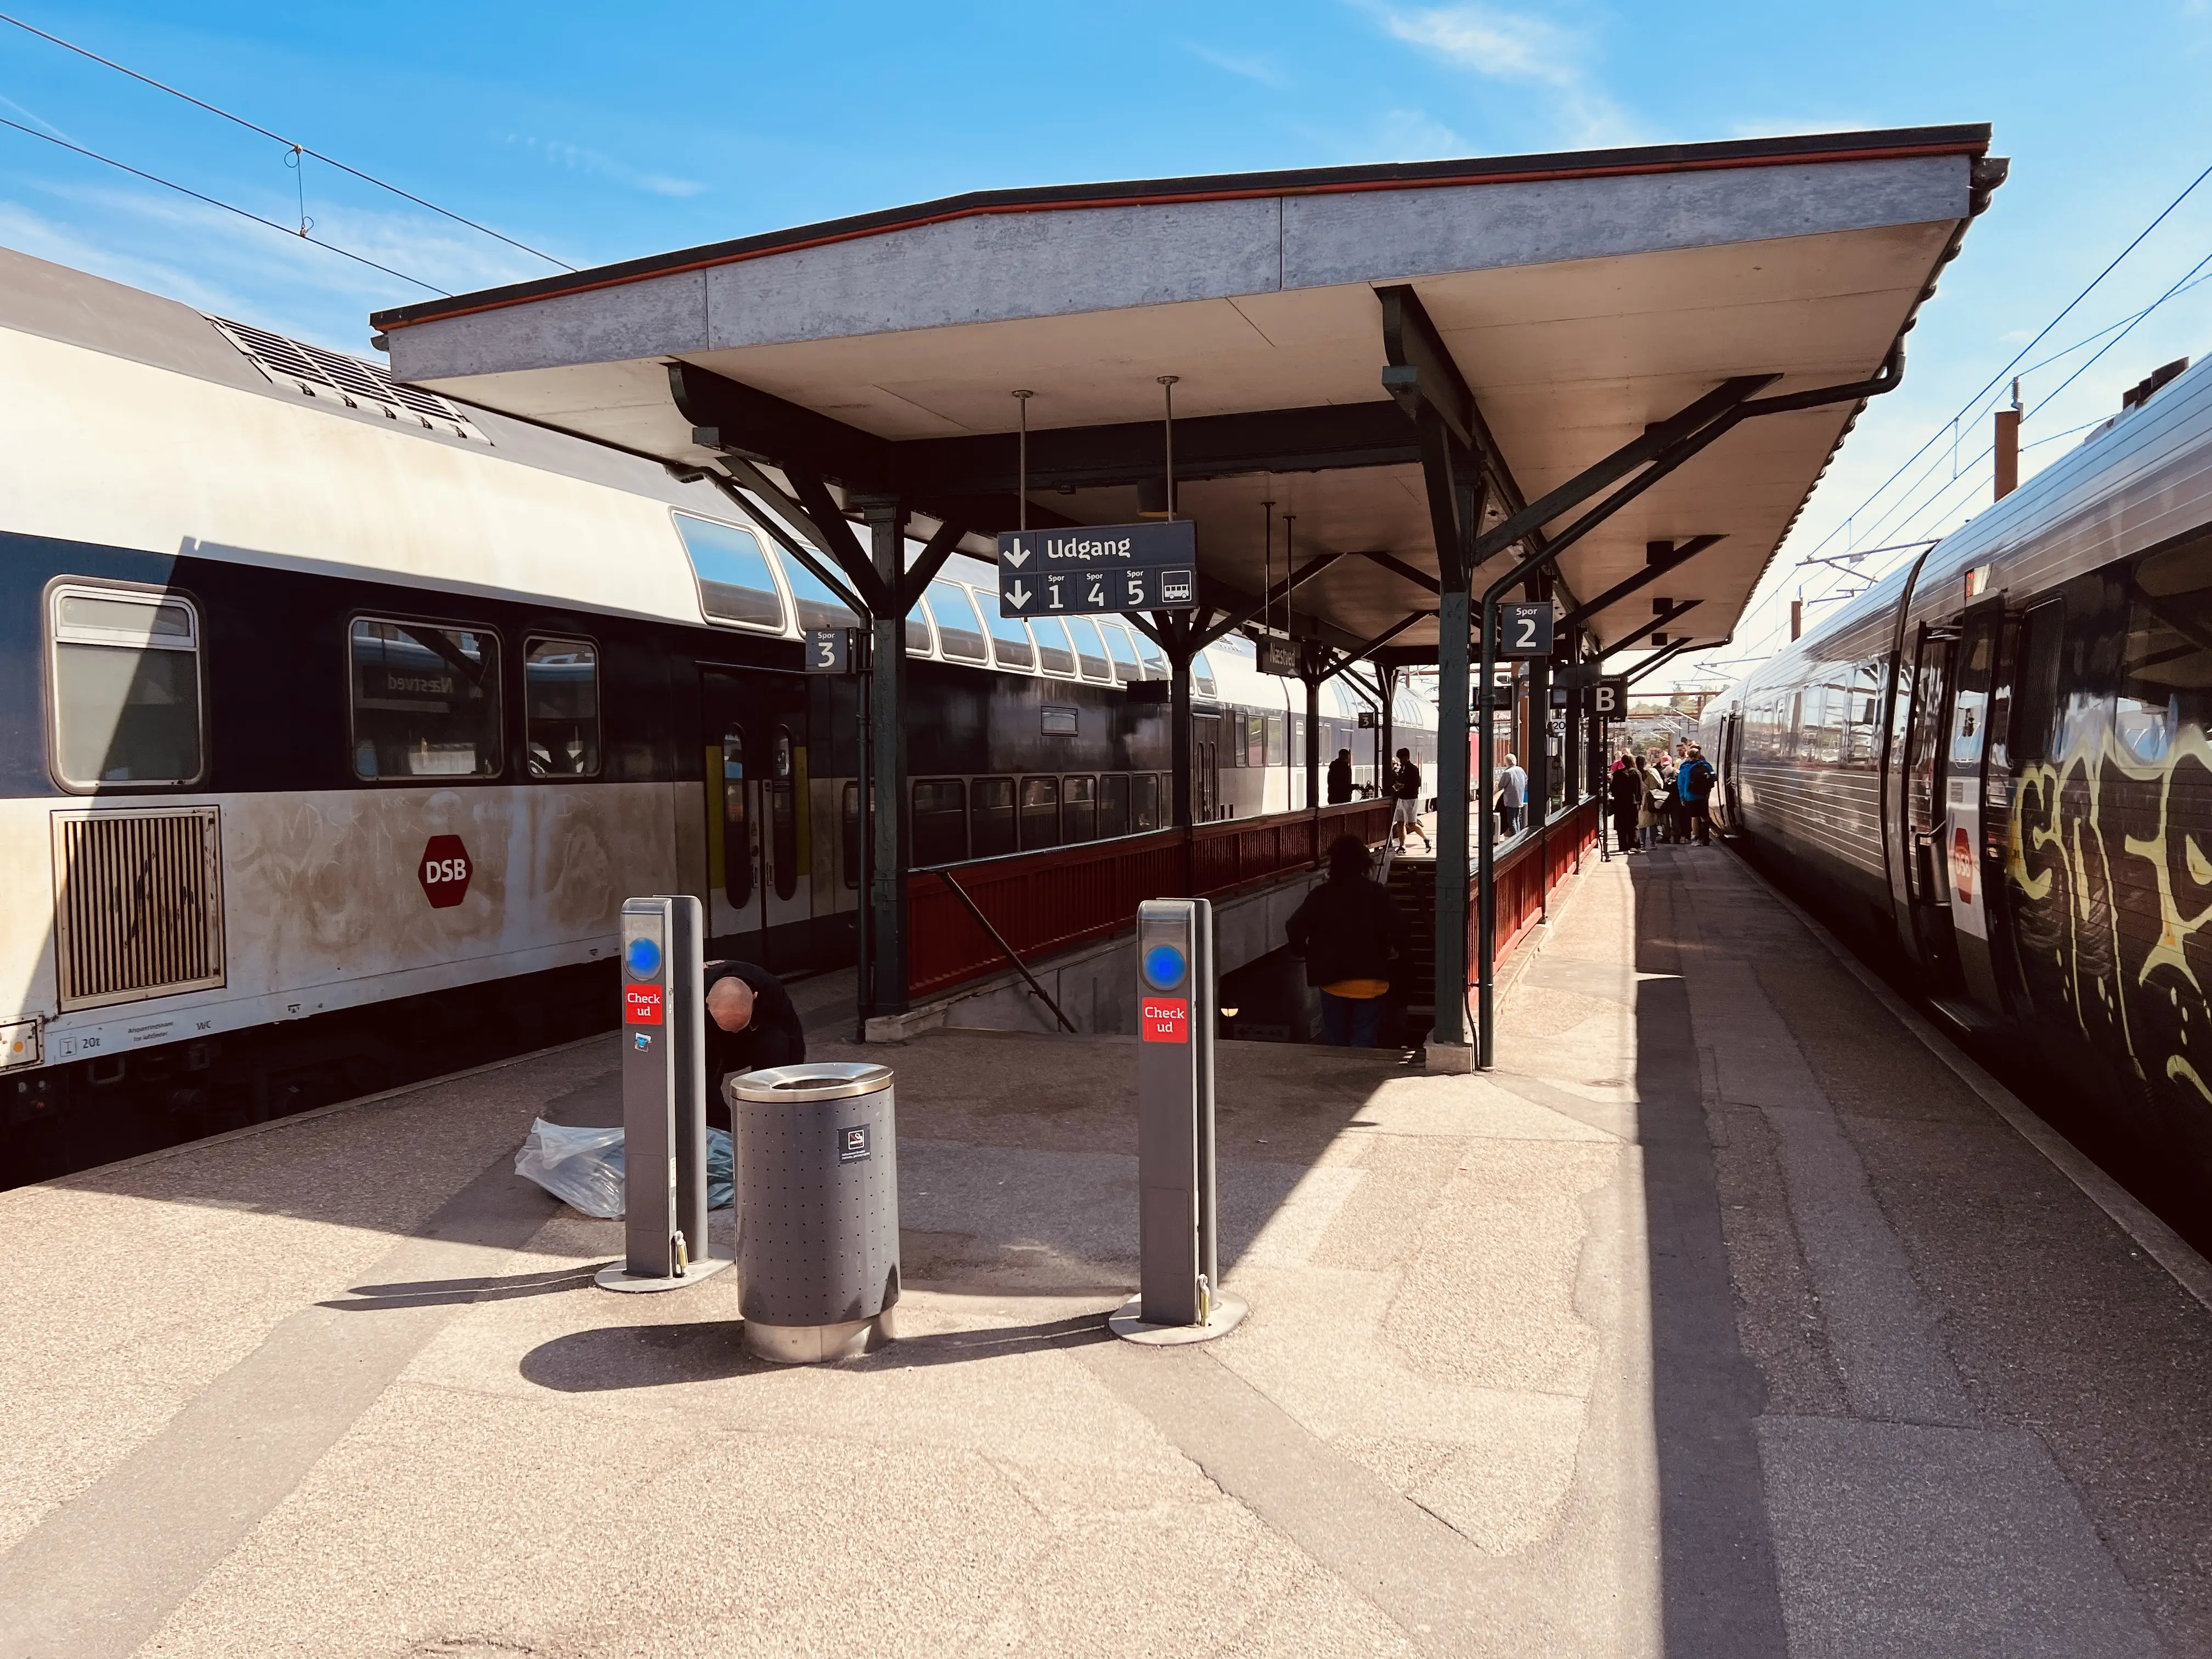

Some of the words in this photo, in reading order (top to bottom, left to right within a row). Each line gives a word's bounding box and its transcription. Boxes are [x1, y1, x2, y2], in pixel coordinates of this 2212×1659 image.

[1047, 537, 1131, 560] Udgang
[1048, 574, 1065, 583] Spor
[1086, 572, 1103, 580] Spor
[1126, 569, 1144, 578] Spor
[1048, 584, 1064, 609] 1
[1087, 582, 1104, 607] 4
[1127, 580, 1145, 605] 5
[1516, 607, 1538, 617] Spor
[817, 631, 835, 640] Spor
[1516, 619, 1536, 647] 2
[818, 642, 835, 667] 3
[1596, 687, 1615, 712] B
[1362, 716, 1369, 726] 3
[426, 859, 466, 883] DSB
[627, 992, 661, 1004] Check
[637, 1006, 651, 1016] ud
[1145, 1006, 1185, 1019] Check
[196, 1020, 212, 1030] WC
[1156, 1021, 1173, 1032] ud
[82, 1037, 101, 1049] 20t
